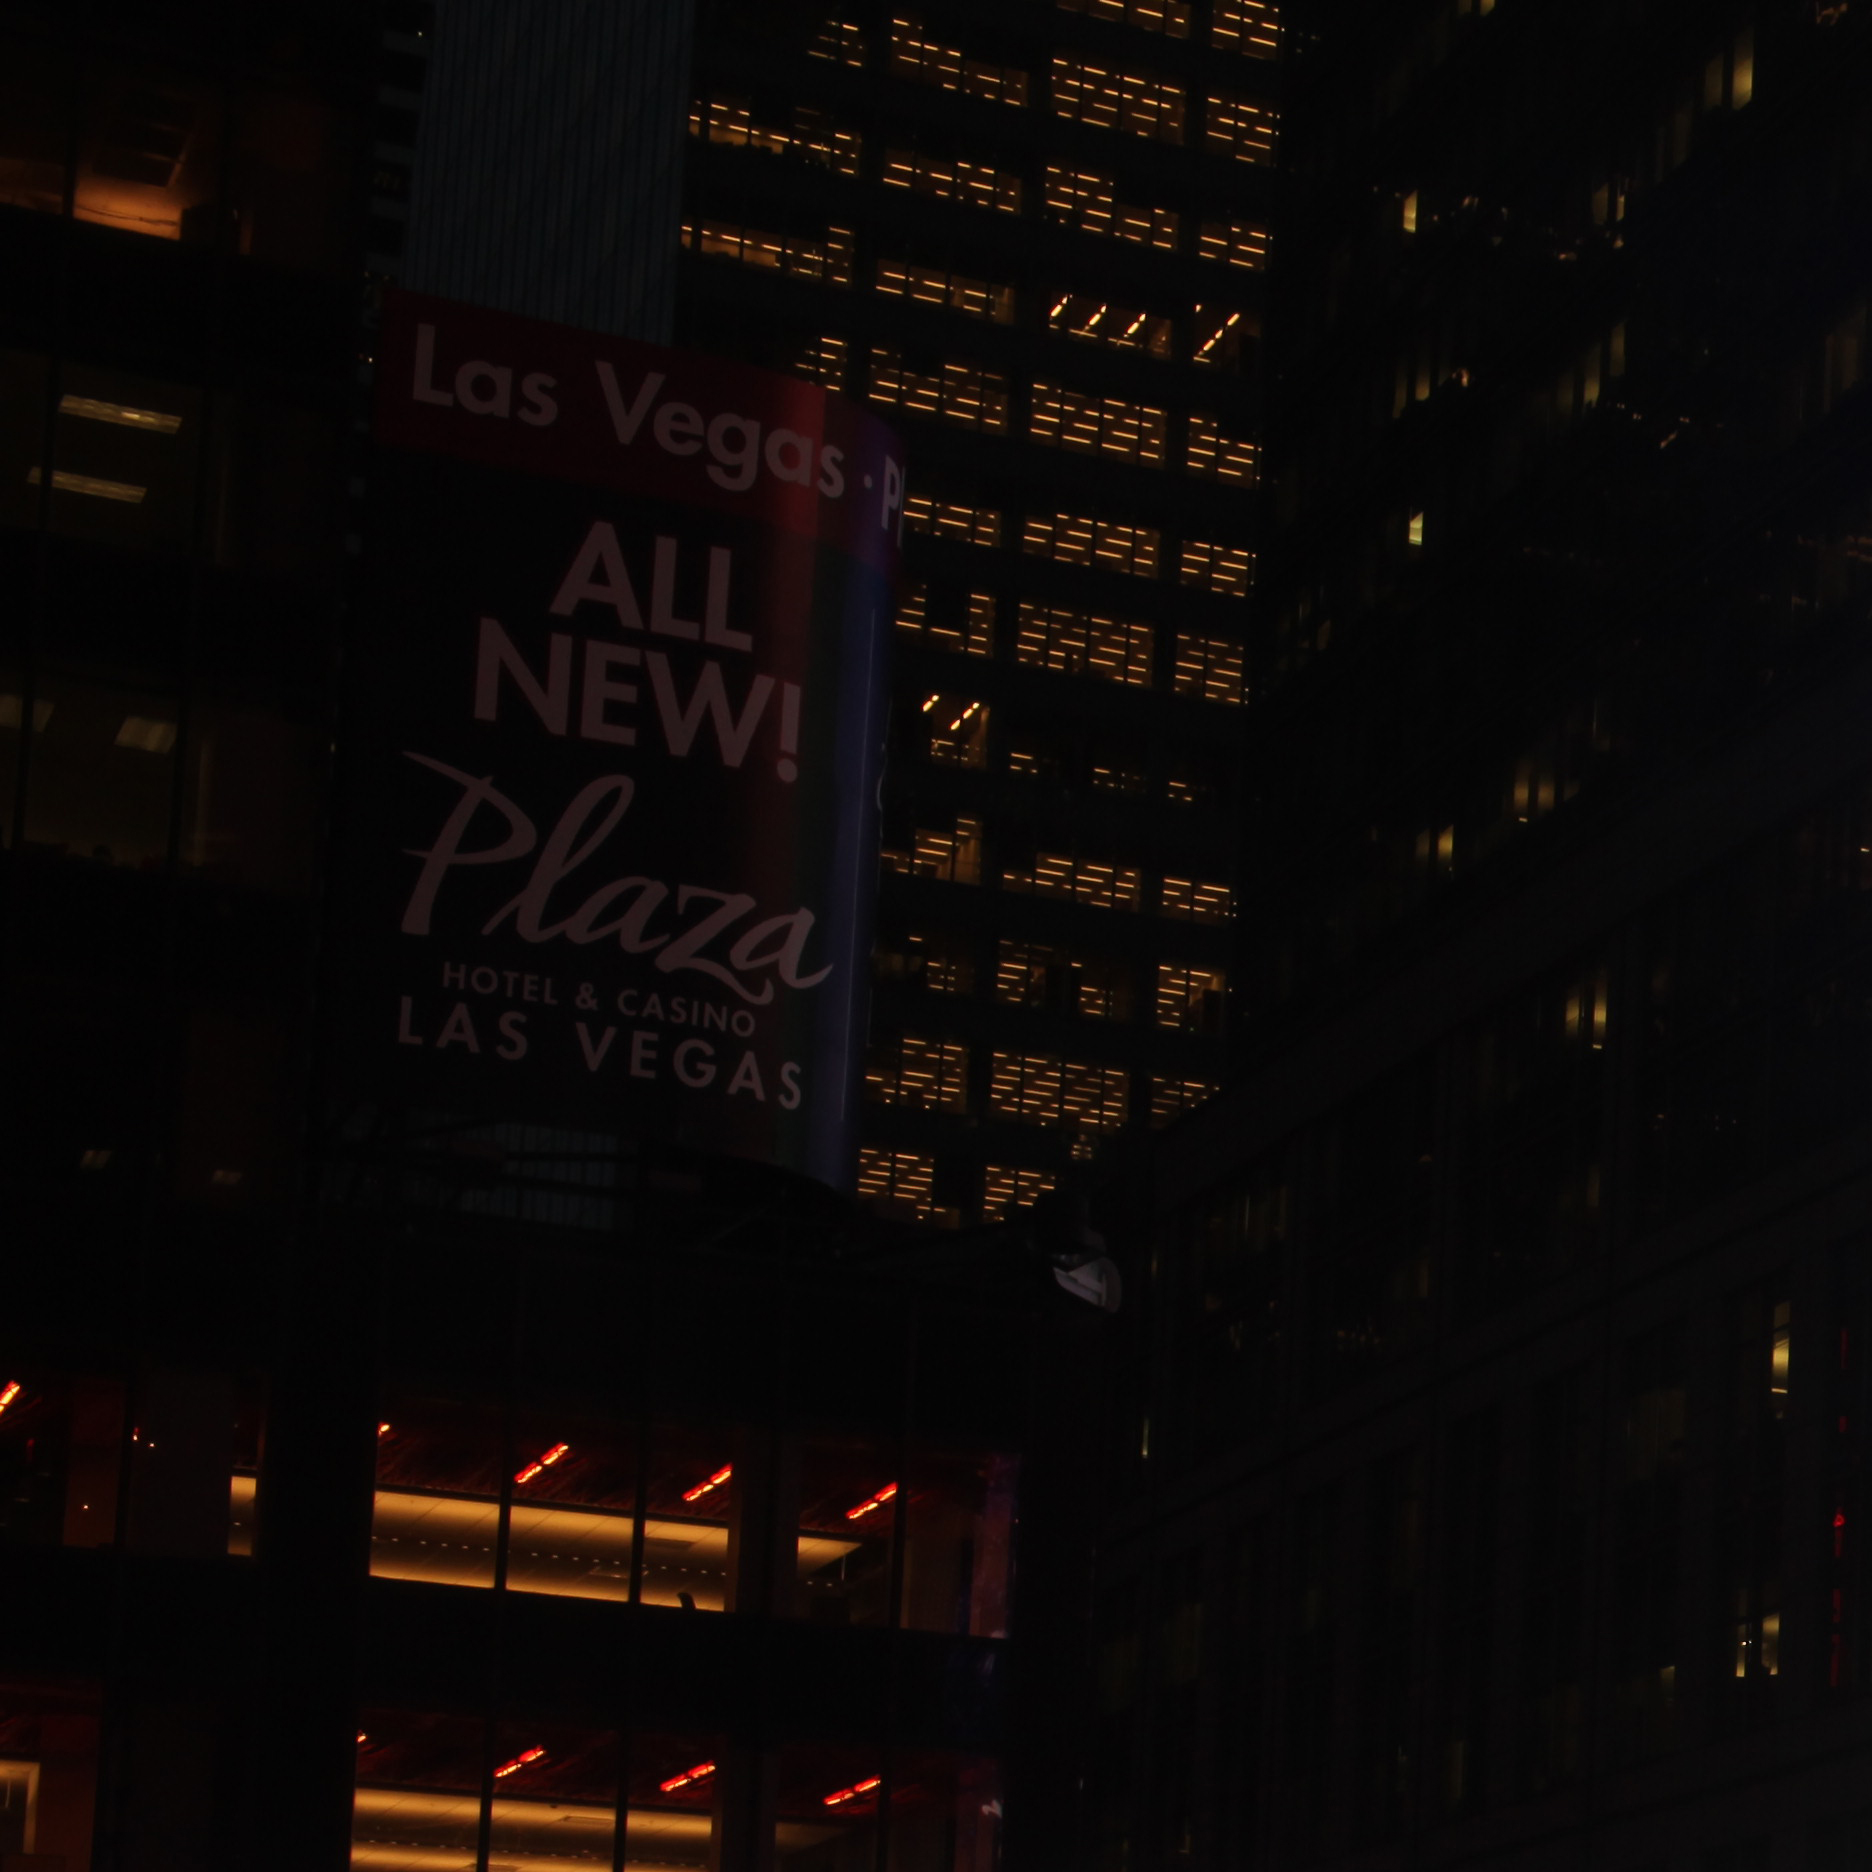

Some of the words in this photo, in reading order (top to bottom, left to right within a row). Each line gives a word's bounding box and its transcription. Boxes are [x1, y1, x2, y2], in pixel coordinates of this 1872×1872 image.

[412, 323, 559, 428] Las
[594, 359, 845, 500] Vegas
[548, 521, 753, 652] ALL
[472, 616, 802, 783] NEW!
[401, 750, 834, 1005] Plaza
[397, 995, 528, 1061] LAS
[575, 1021, 802, 1112] VEGAS
[442, 961, 558, 1007] HOTEL
[575, 982, 599, 1011] &
[617, 989, 756, 1038] CASINO
